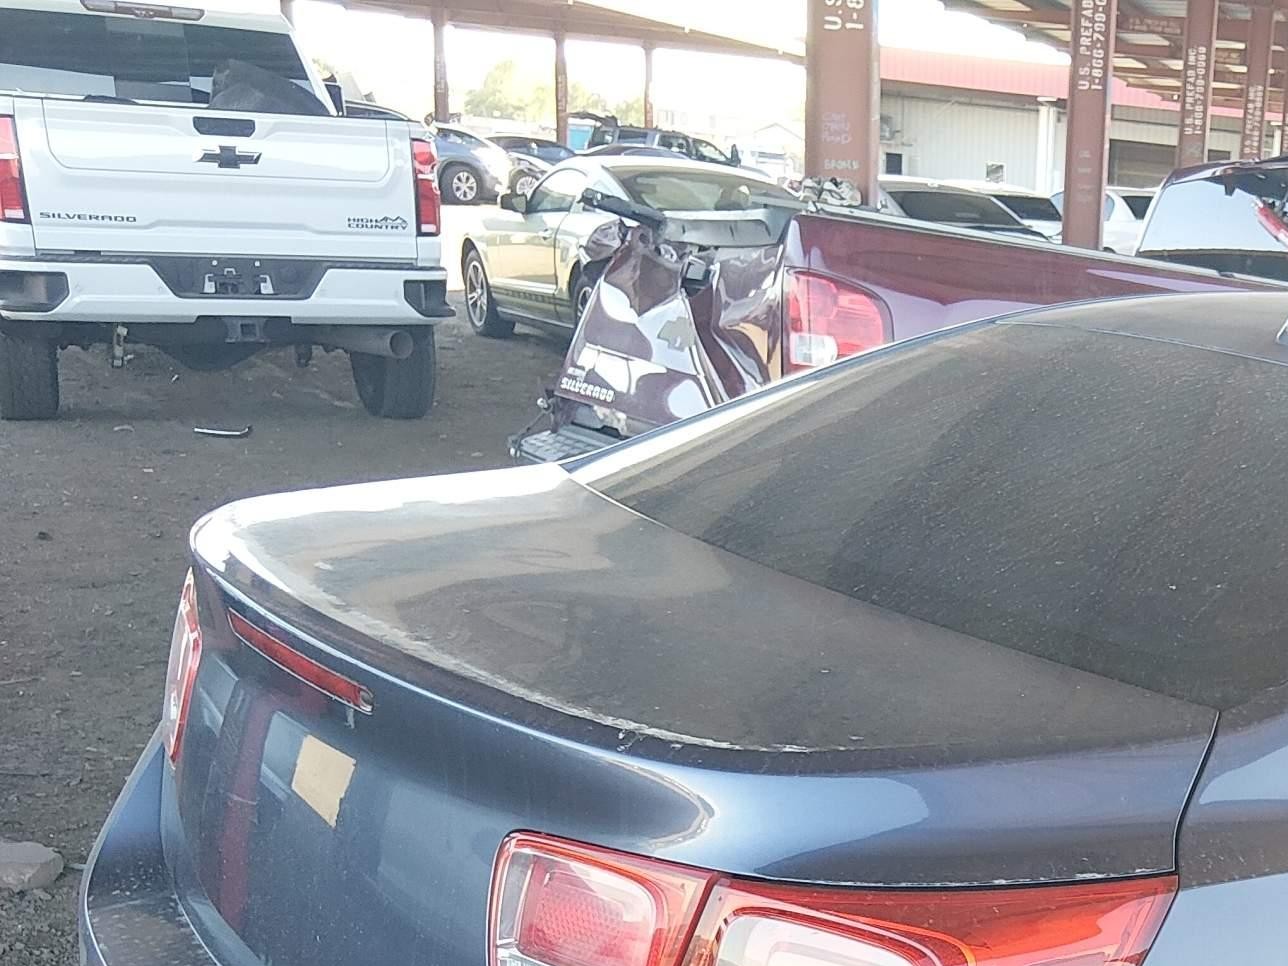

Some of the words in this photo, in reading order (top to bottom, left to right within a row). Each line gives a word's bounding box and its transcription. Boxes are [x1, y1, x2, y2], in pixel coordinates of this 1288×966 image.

[1080, 0, 1095, 55] PREFAB
[1185, 70, 1196, 110] PREFAB
[39, 211, 137, 223] SILVERADO
[347, 223, 407, 231] COUNTRY
[559, 376, 615, 403] SILVERADO
